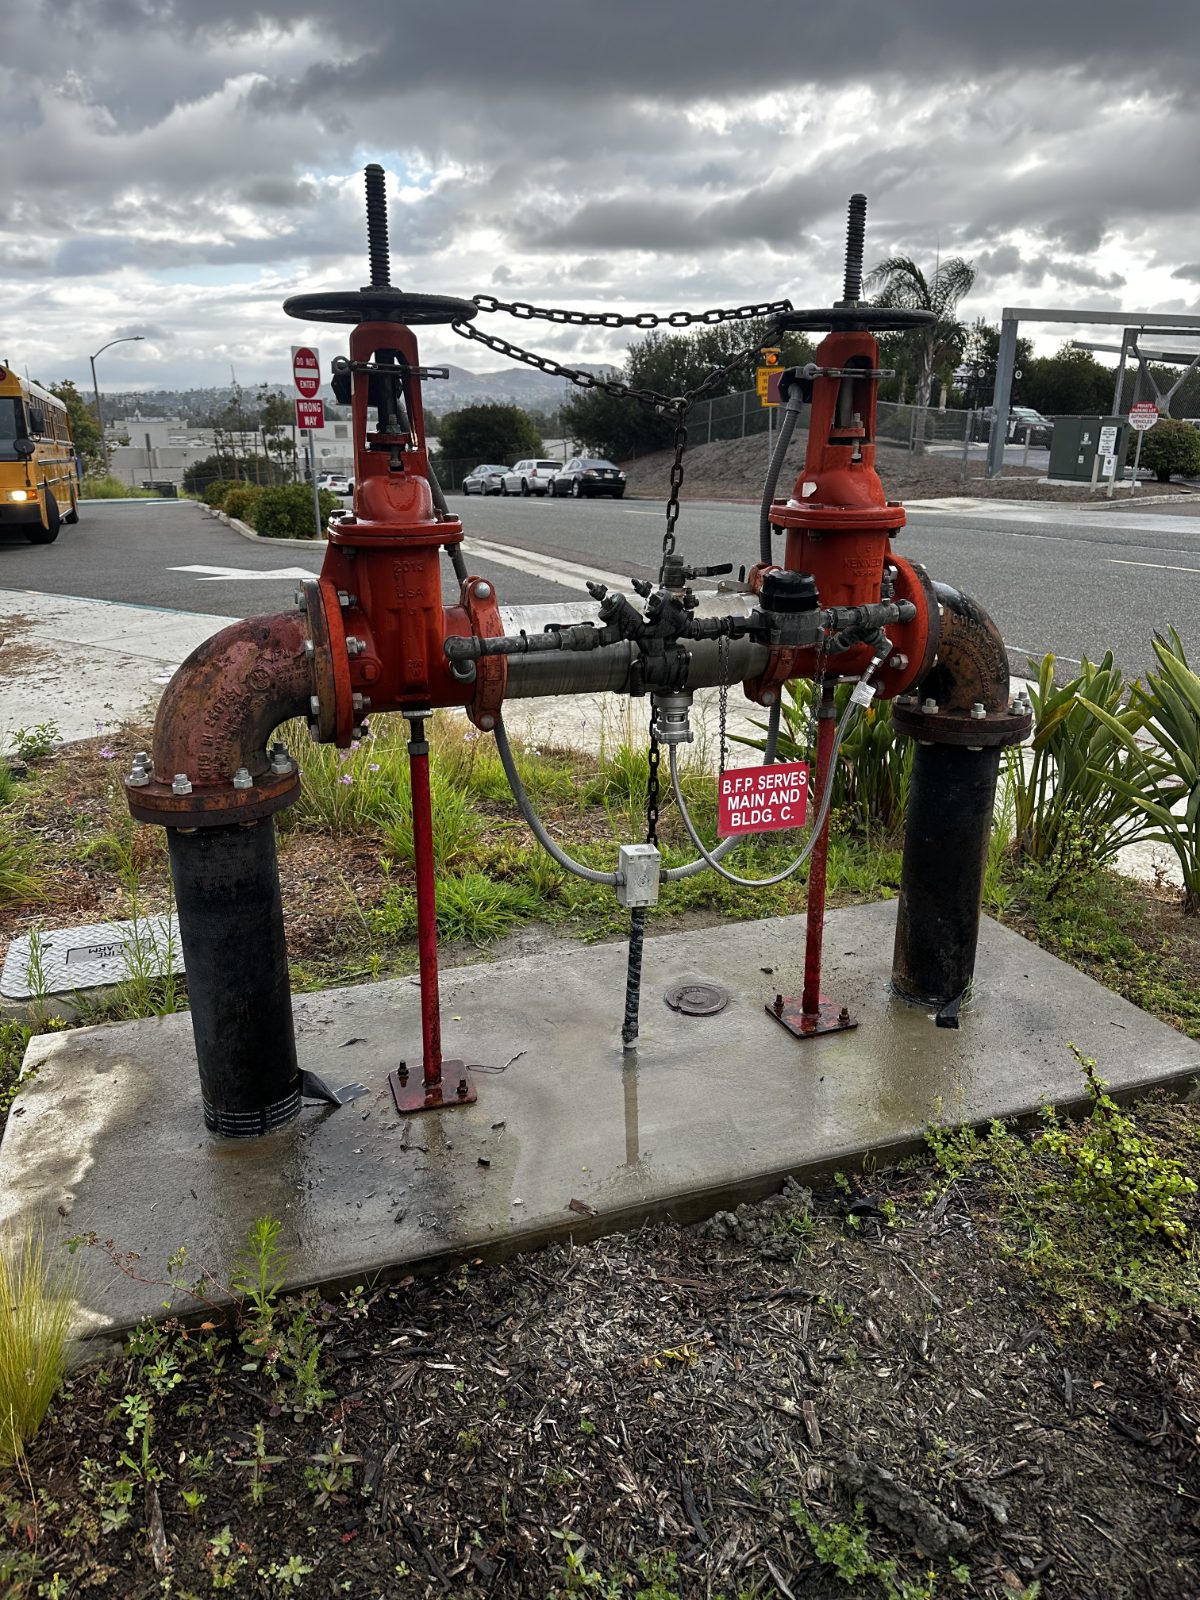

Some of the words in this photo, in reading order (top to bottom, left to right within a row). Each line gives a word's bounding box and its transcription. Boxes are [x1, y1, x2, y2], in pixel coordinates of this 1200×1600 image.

[296, 357, 304, 365] DO
[305, 358, 316, 366] NOT
[300, 380, 316, 388] ENTER
[298, 402, 321, 412] WRONG
[304, 415, 317, 426] WAY
[722, 777, 754, 794] B.F.P.
[757, 770, 807, 790] SERVES
[727, 792, 765, 811] MAIN
[768, 788, 800, 806] AND
[731, 808, 776, 827] BLDG.
[780, 806, 795, 820] C.
[96, 949, 124, 958] FIRE
